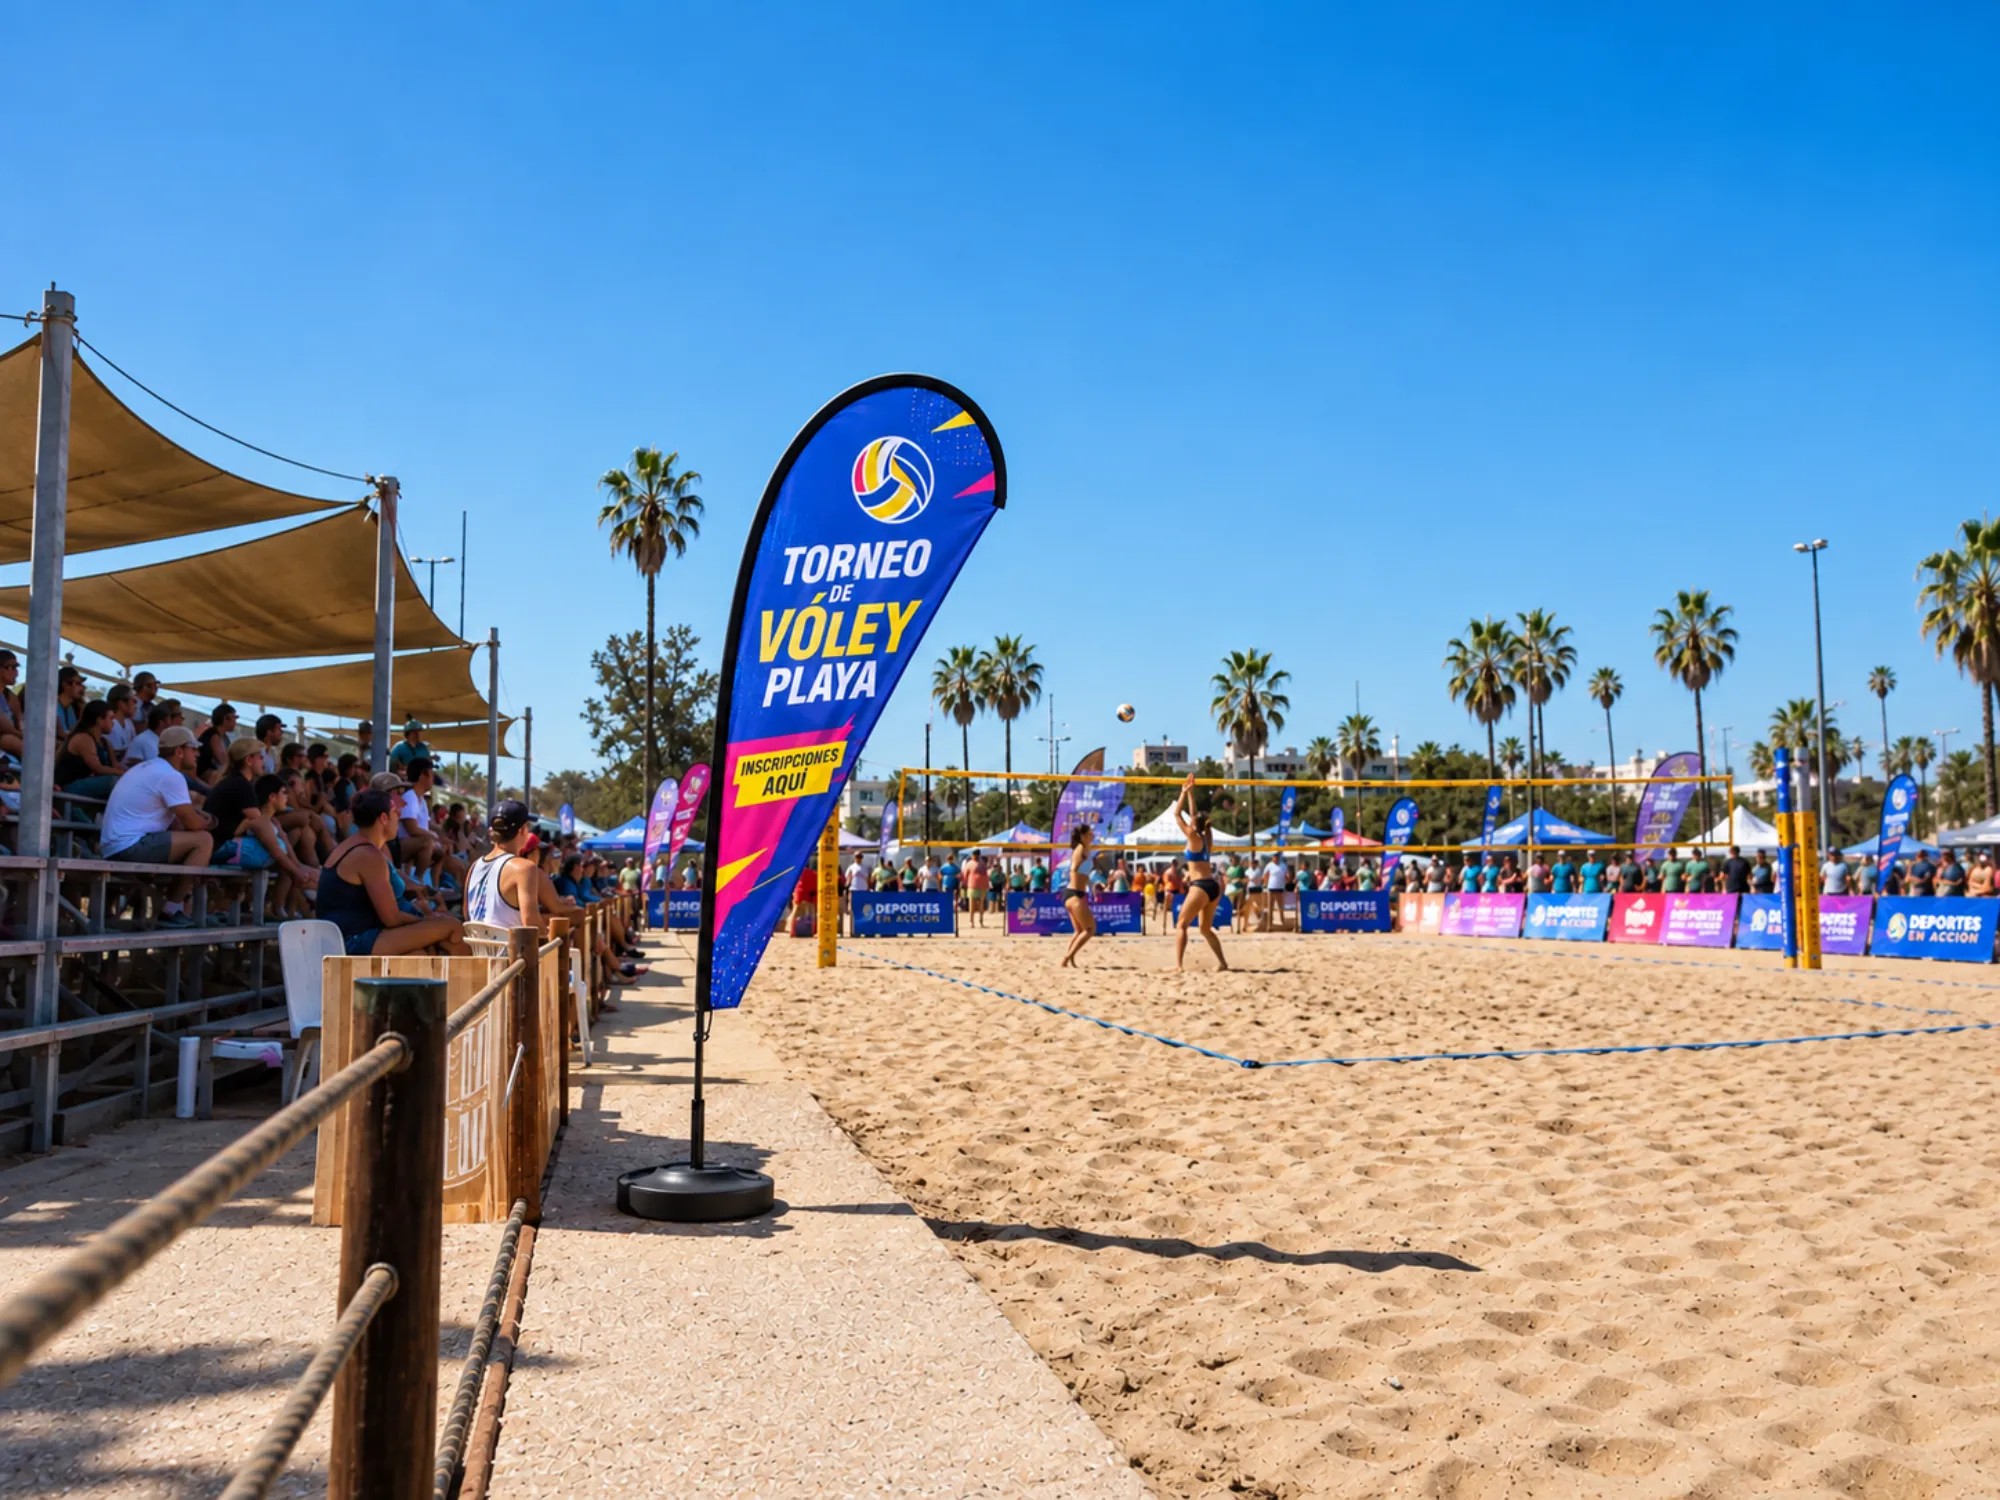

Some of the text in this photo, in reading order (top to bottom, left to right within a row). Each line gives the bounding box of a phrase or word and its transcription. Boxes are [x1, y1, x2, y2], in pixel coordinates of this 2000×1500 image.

[783, 539, 932, 585] TORNEO
[828, 583, 853, 603] DE
[759, 592, 922, 663] VÓLEY
[762, 660, 877, 708] PLAYA
[740, 747, 840, 777] INSCRIPCIONES
[762, 767, 808, 797] AQUÍ
[875, 903, 940, 914] DEPORTES
[1320, 901, 1377, 911] DEPORTES
[1908, 914, 1982, 932] DEPORTES
[1907, 930, 1979, 944] EN ACCION
